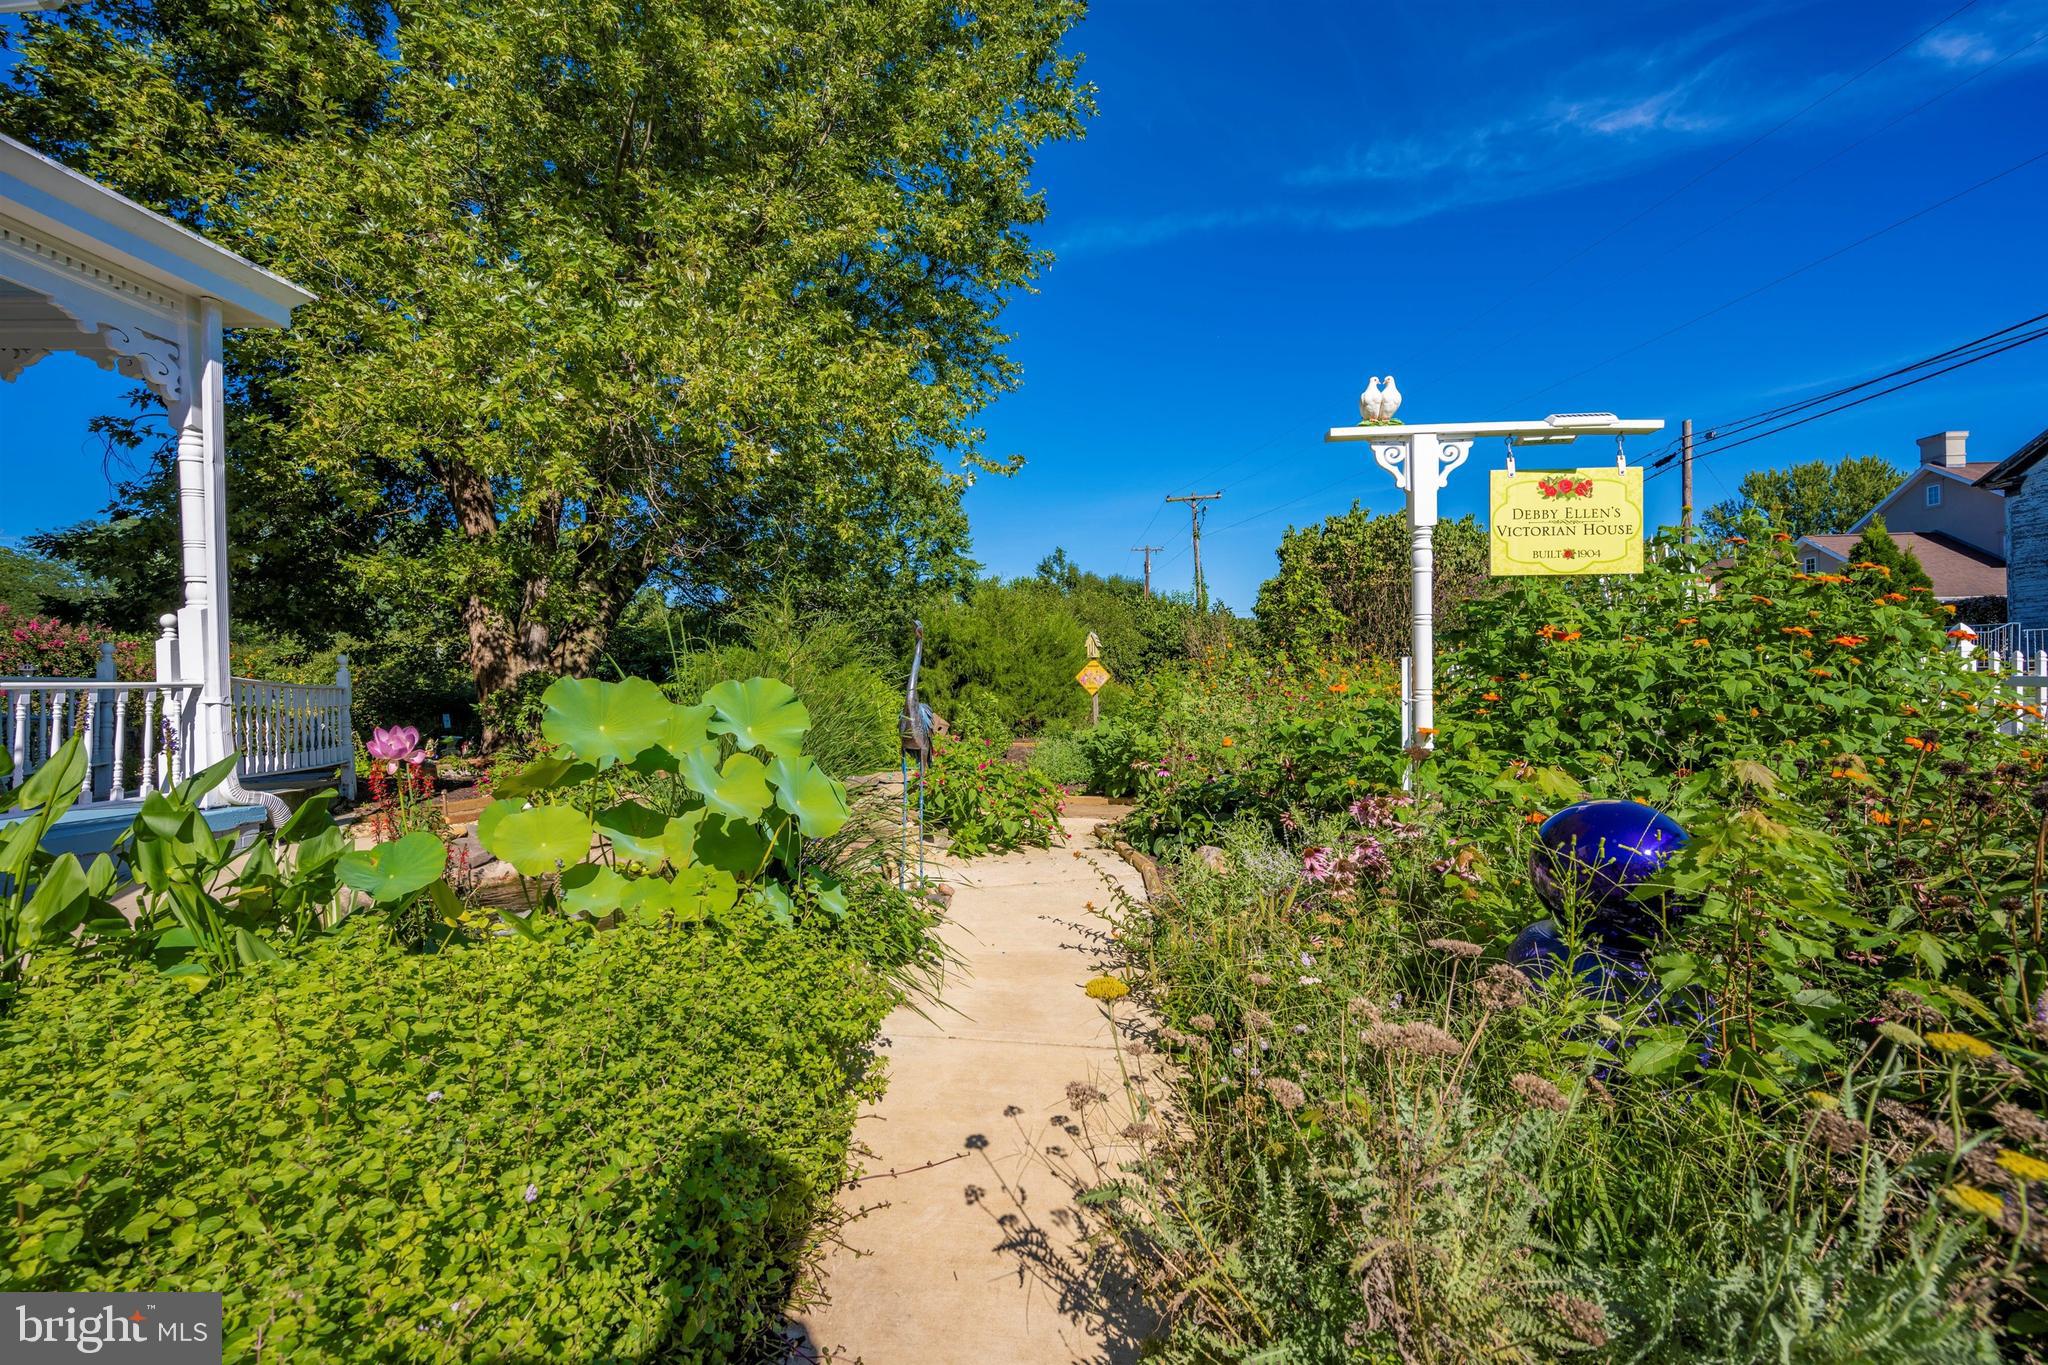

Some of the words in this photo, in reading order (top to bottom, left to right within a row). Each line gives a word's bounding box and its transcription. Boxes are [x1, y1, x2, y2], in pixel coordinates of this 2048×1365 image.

[1512, 508, 1558, 520] DEBBY
[1565, 506, 1621, 519] ELLEN'S
[1496, 525, 1576, 537] VICTORIAN
[1584, 524, 1633, 535] HOUSE
[1532, 550, 1562, 559] BUILT
[1577, 549, 1601, 558] 1904
